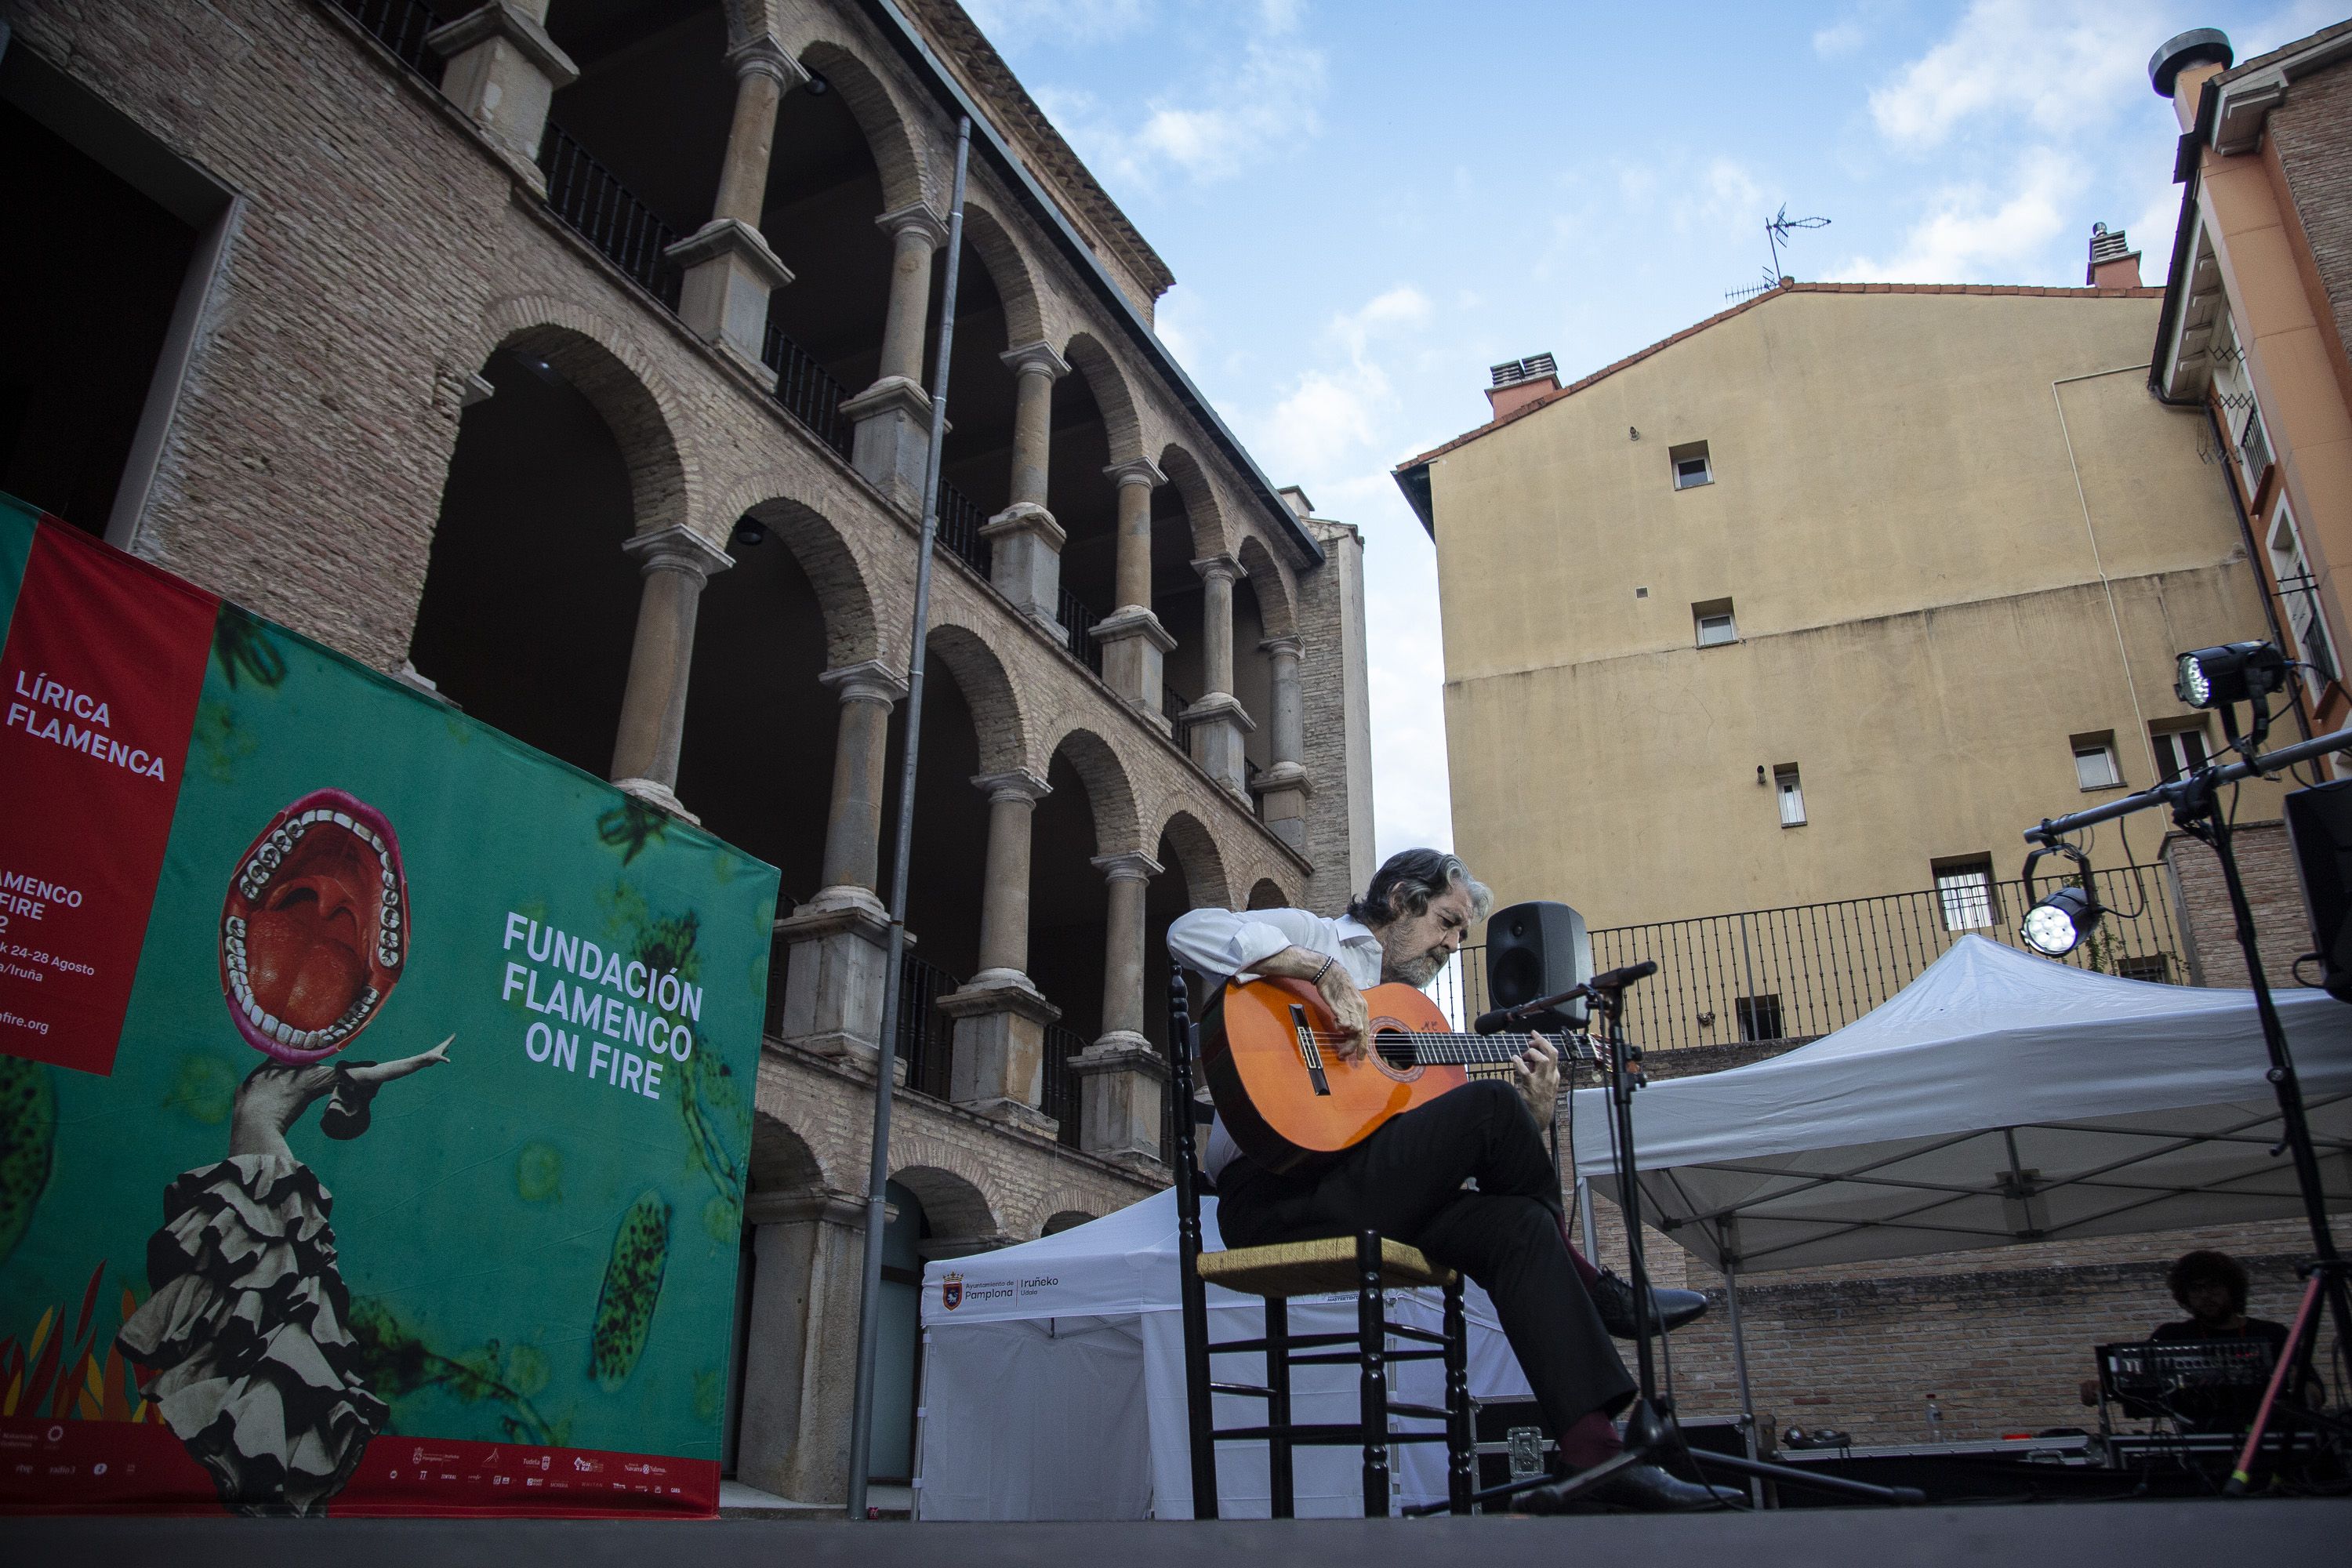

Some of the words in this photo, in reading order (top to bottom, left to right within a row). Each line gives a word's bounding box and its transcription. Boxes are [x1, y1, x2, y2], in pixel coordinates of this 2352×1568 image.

[15, 670, 111, 728] LÍRICA
[6, 703, 165, 781] FLAMENCA
[0, 869, 82, 908] MENCO
[10, 945, 49, 964] 24-28
[51, 956, 95, 976] Agosto
[503, 911, 703, 1022] FUNDACIÓN
[503, 961, 691, 1062] FLAMENCO
[525, 1022, 579, 1073] ON
[589, 1041, 663, 1100] FIRE
[965, 1281, 1005, 1290] Ayuntamiento
[965, 1288, 1013, 1301] Pamplona
[1021, 1276, 1058, 1288] Iruñeko
